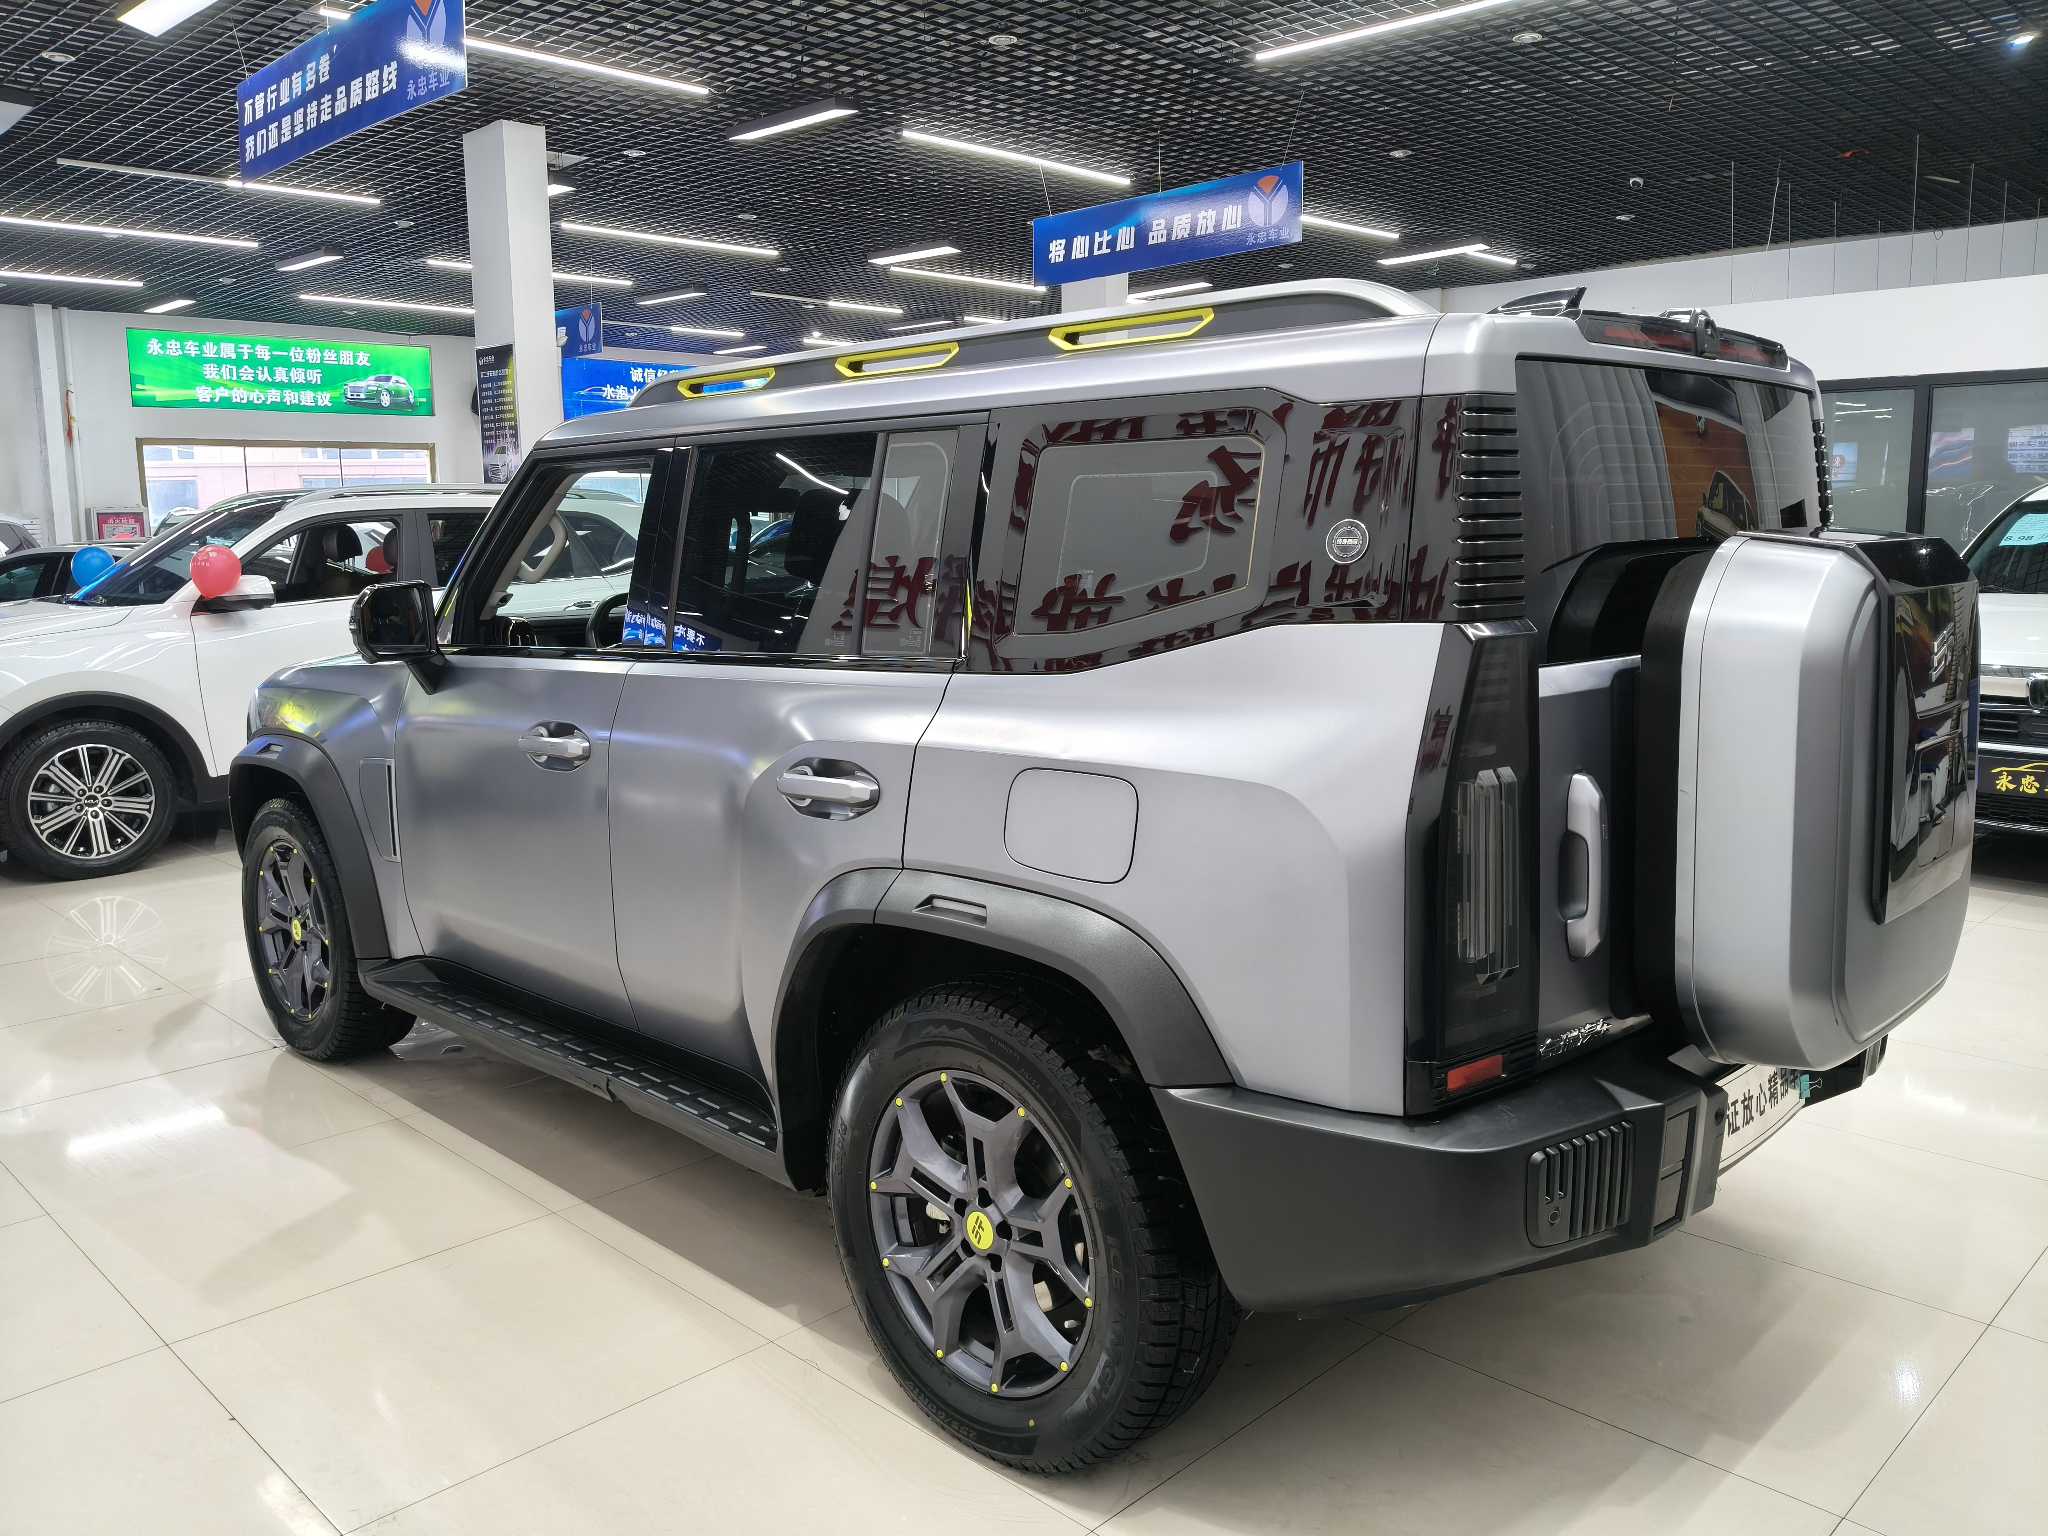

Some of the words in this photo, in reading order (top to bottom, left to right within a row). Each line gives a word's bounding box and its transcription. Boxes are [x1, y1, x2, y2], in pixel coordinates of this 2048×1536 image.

[406, 71, 450, 101] 永忠车业
[245, 60, 398, 163] 我们还是坚持走品质路线
[1049, 226, 1135, 263] 将心比心
[1148, 204, 1242, 245] 品质放心
[1245, 226, 1289, 246] 永忠车业
[147, 338, 371, 367] 永忠车业属于每一位粉丝朋友
[203, 363, 323, 385] 我们会认真倾听
[630, 367, 679, 383] 诚信经
[195, 386, 333, 408] 客户的心声和建议
[1995, 771, 2048, 794] 永忠
